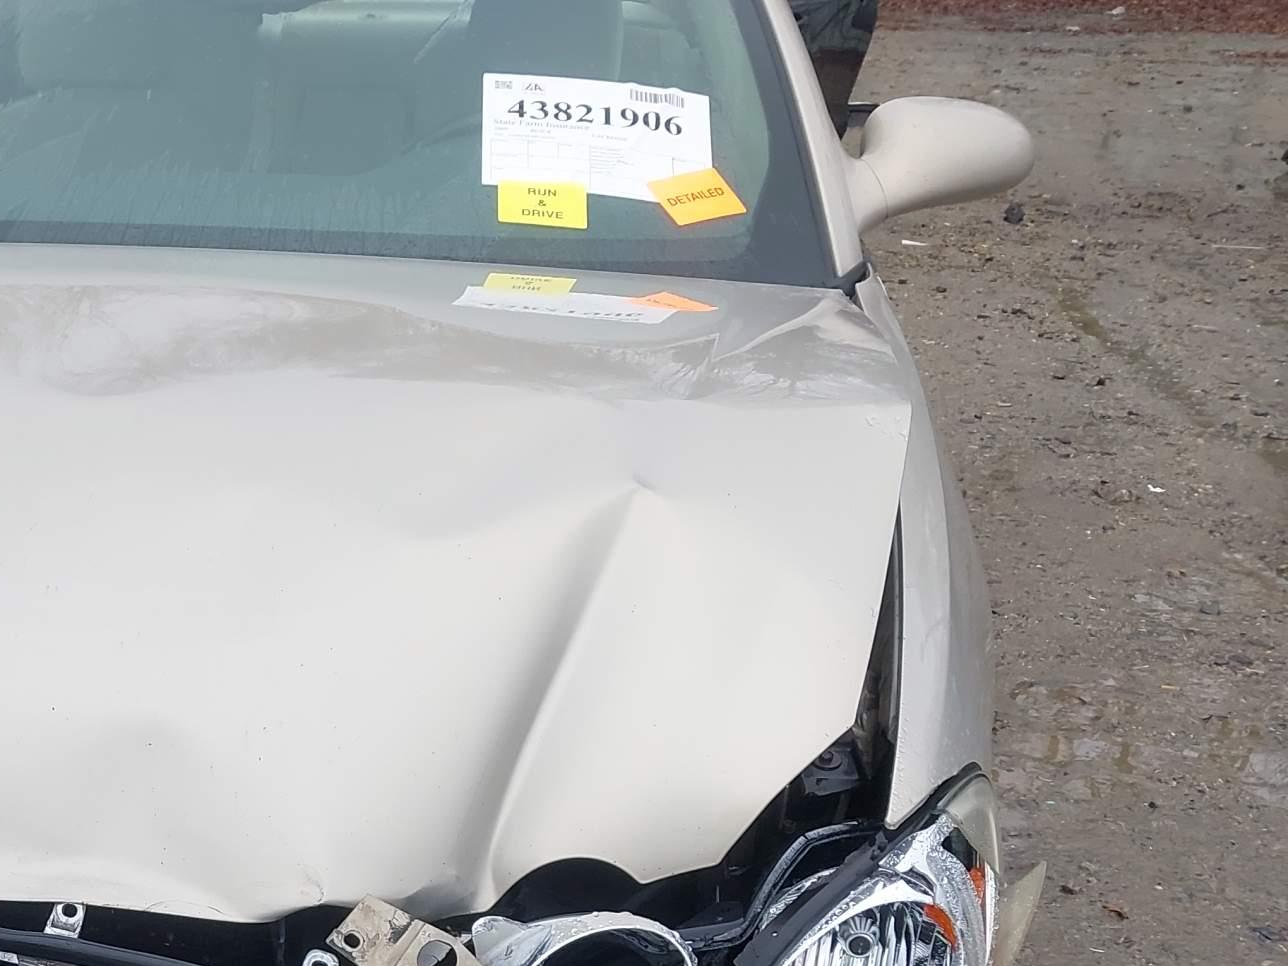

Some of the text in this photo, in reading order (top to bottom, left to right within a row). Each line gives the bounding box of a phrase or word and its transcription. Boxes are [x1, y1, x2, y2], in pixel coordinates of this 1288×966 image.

[507, 99, 683, 136] 43821906
[527, 187, 557, 197] RUN
[666, 187, 725, 206] DETAILED
[537, 199, 547, 207] &
[521, 208, 564, 219] DRIVE
